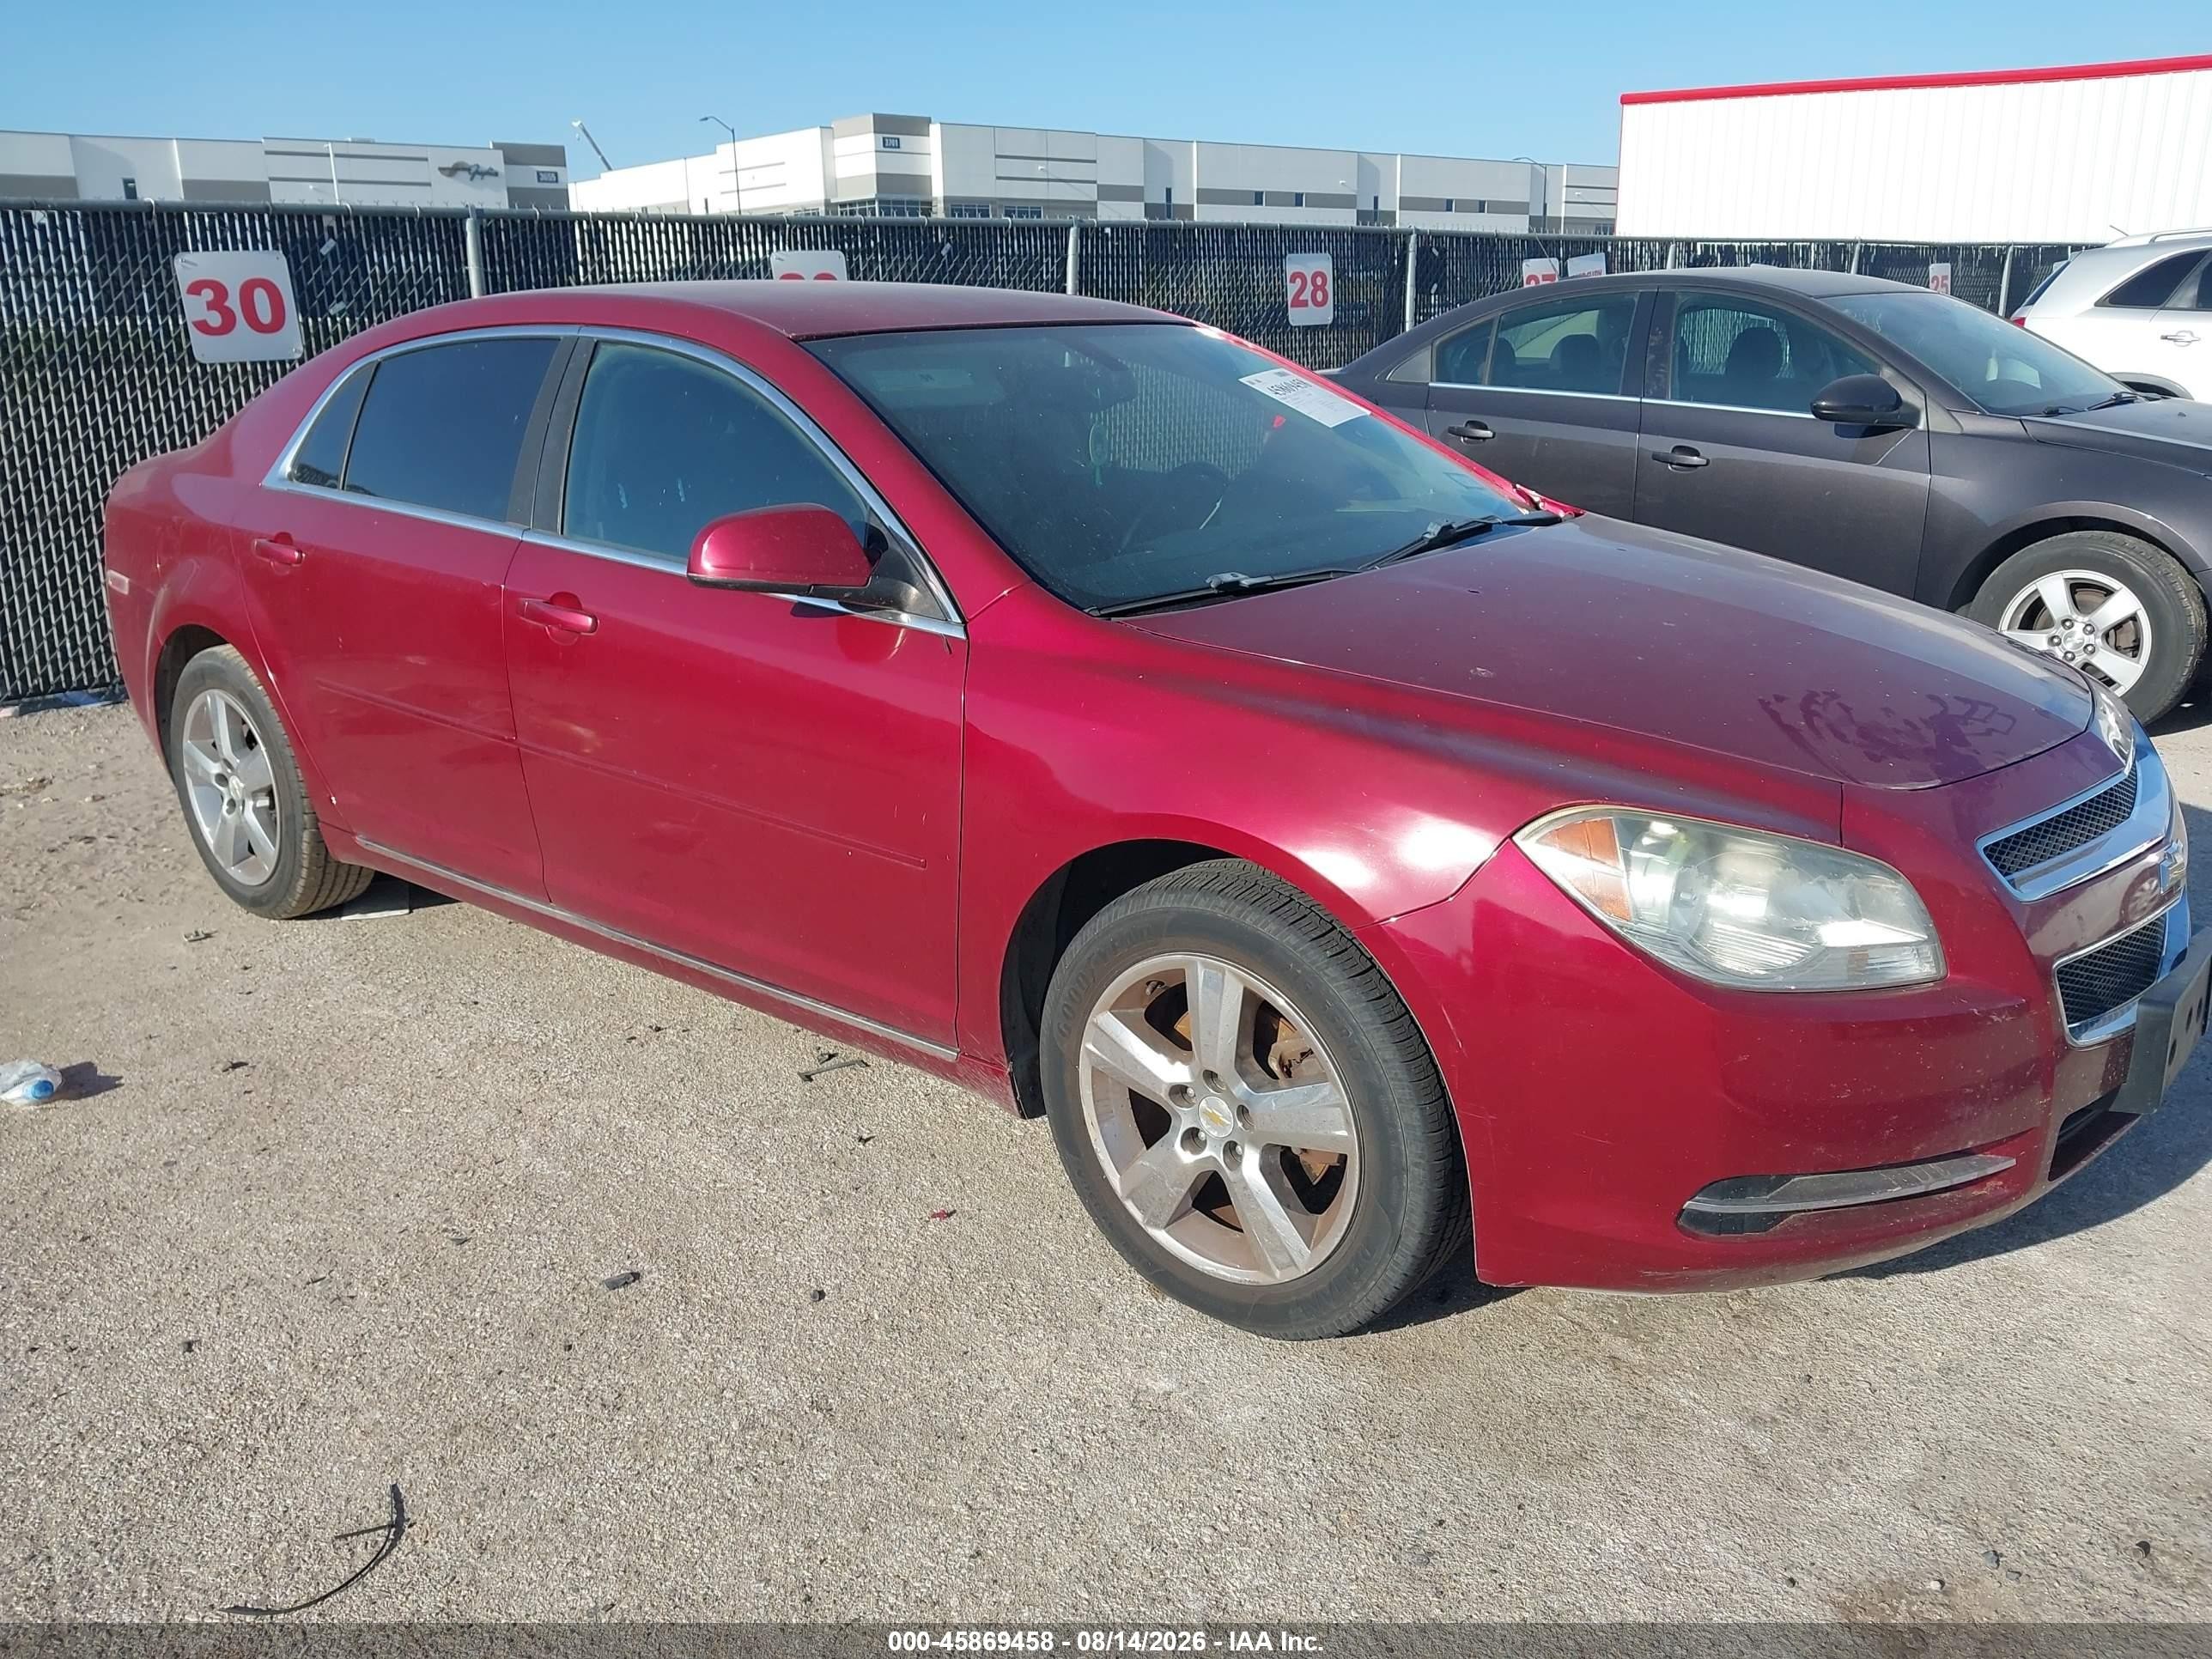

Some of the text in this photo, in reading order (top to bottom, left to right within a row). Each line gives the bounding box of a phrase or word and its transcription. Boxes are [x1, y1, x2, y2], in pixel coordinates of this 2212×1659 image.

[1289, 270, 1328, 307] 28
[1931, 275, 1949, 295] 25
[185, 277, 286, 336] 30
